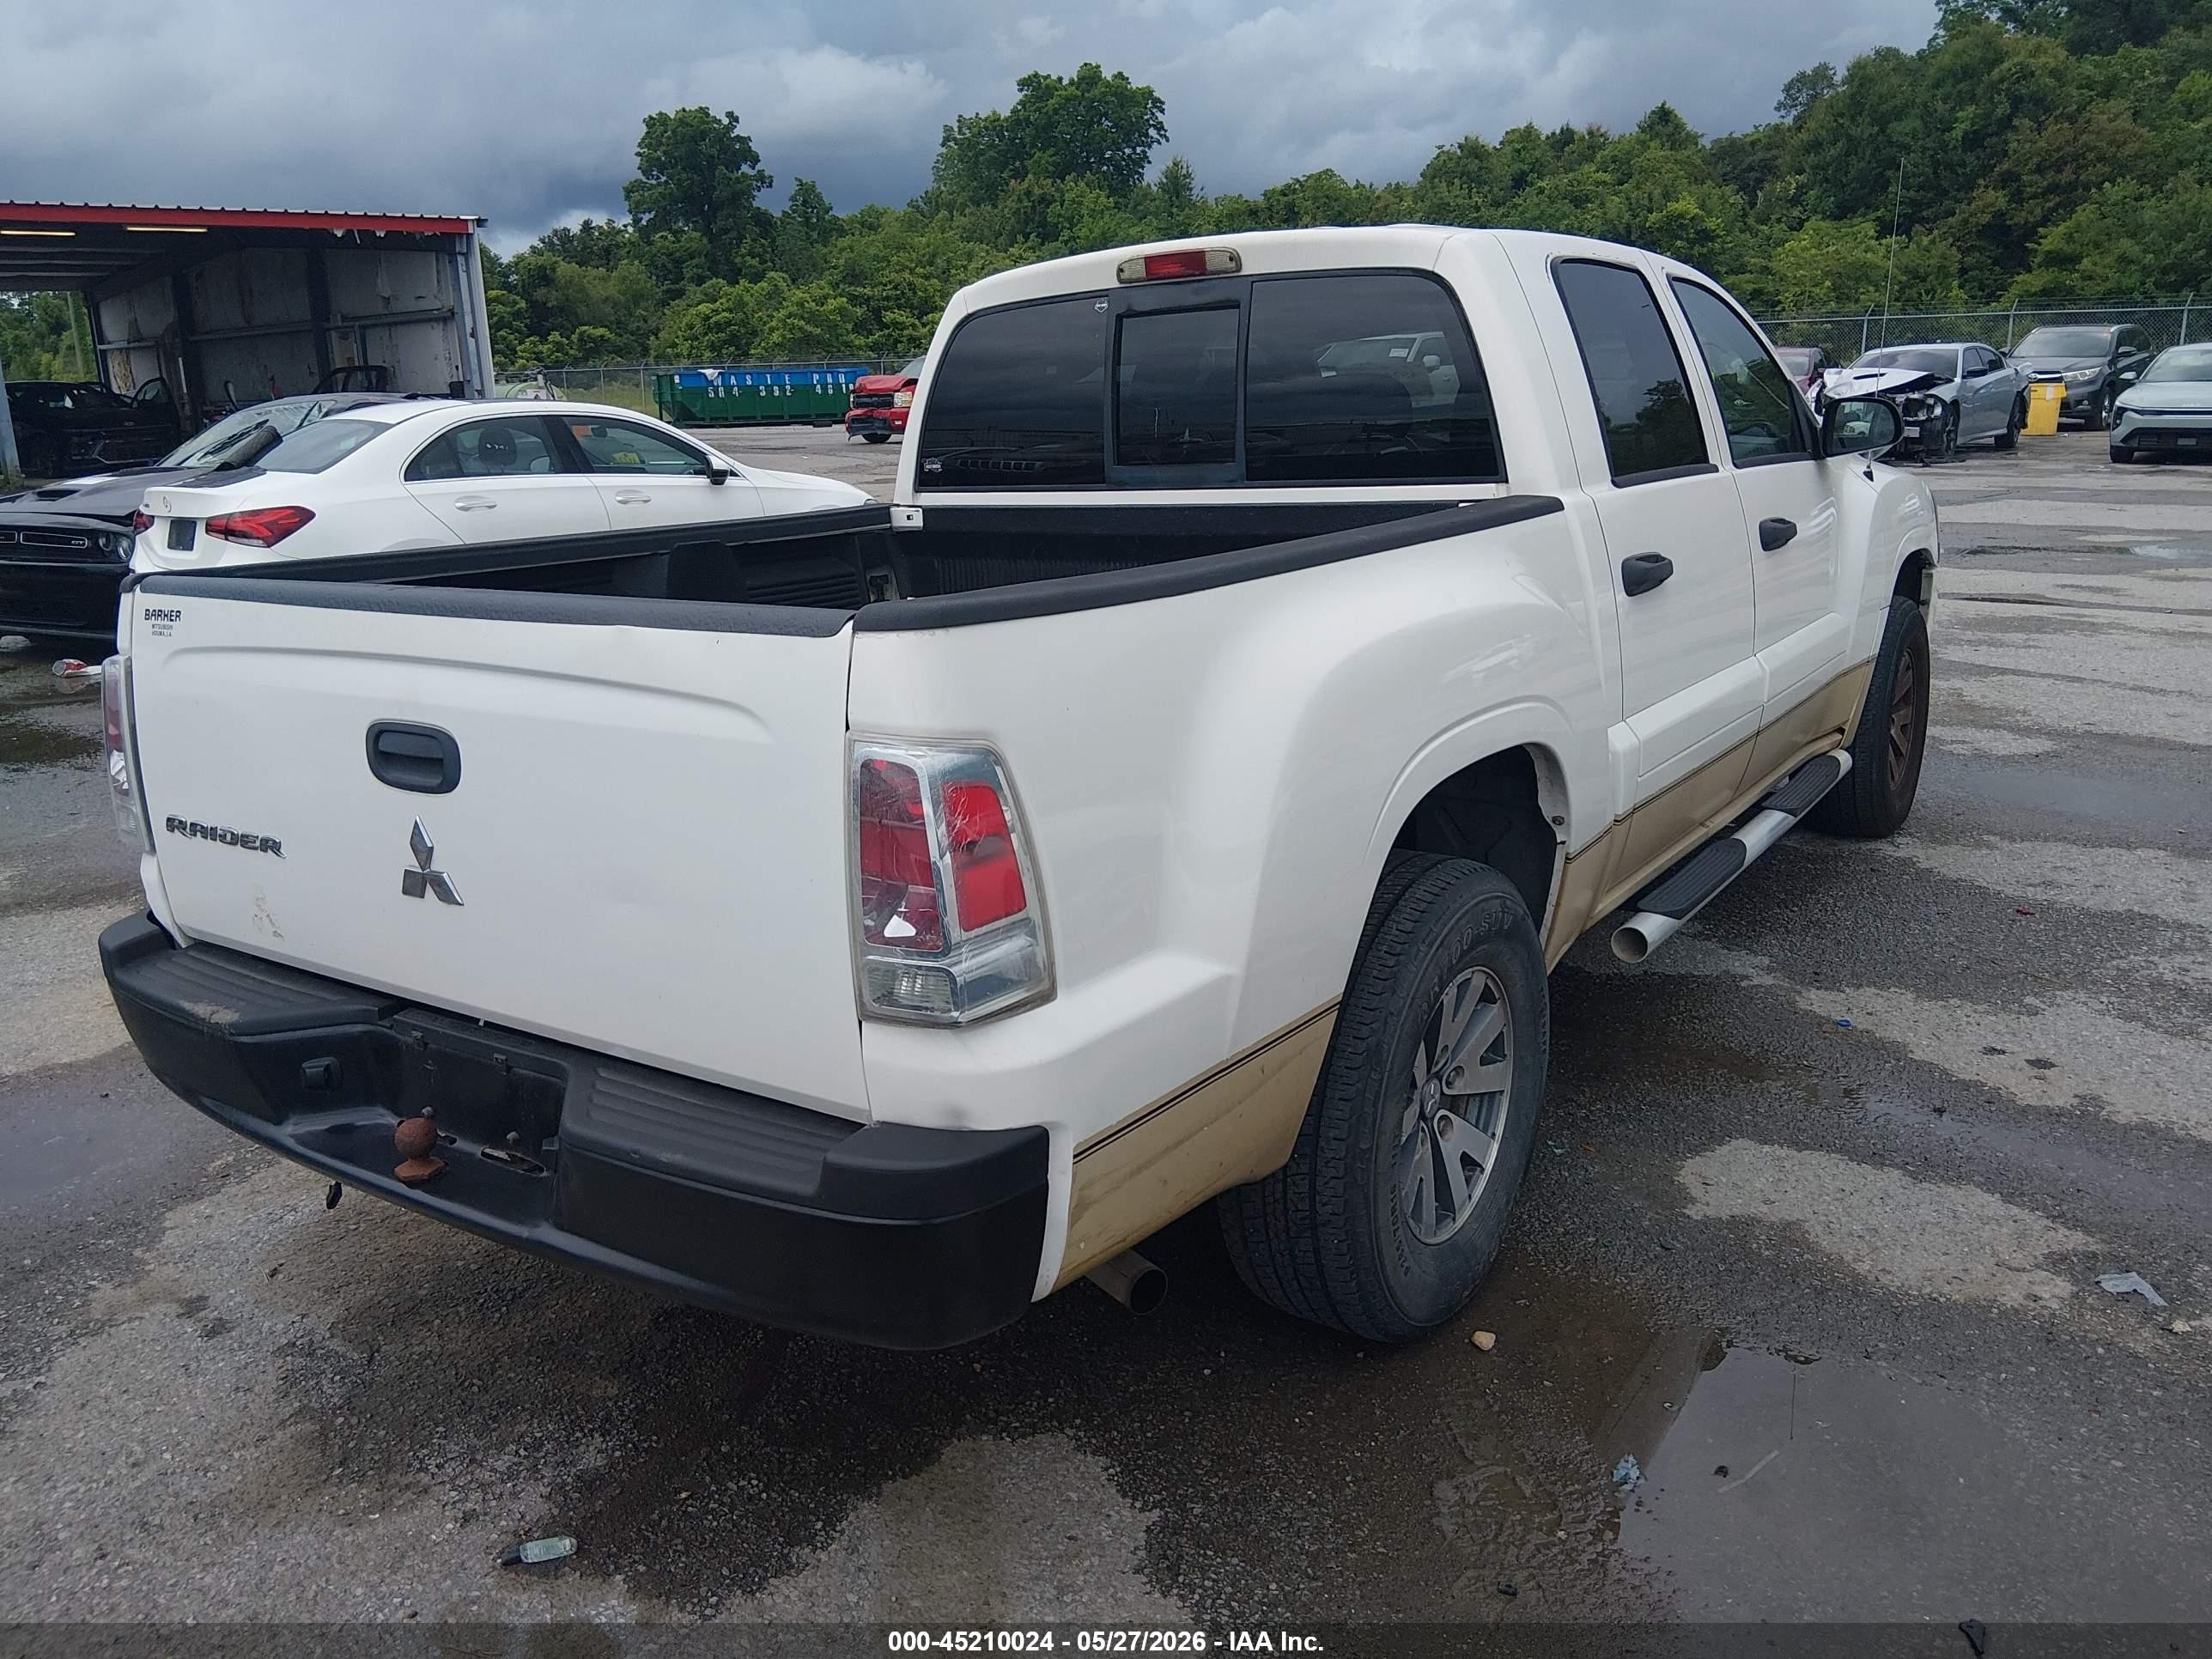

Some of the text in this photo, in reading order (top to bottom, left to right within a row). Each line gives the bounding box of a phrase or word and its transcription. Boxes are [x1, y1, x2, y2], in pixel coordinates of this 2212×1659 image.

[713, 373, 846, 386] WASTE PRO
[144, 608, 182, 623] BARKER
[166, 813, 289, 860] RAIDER
